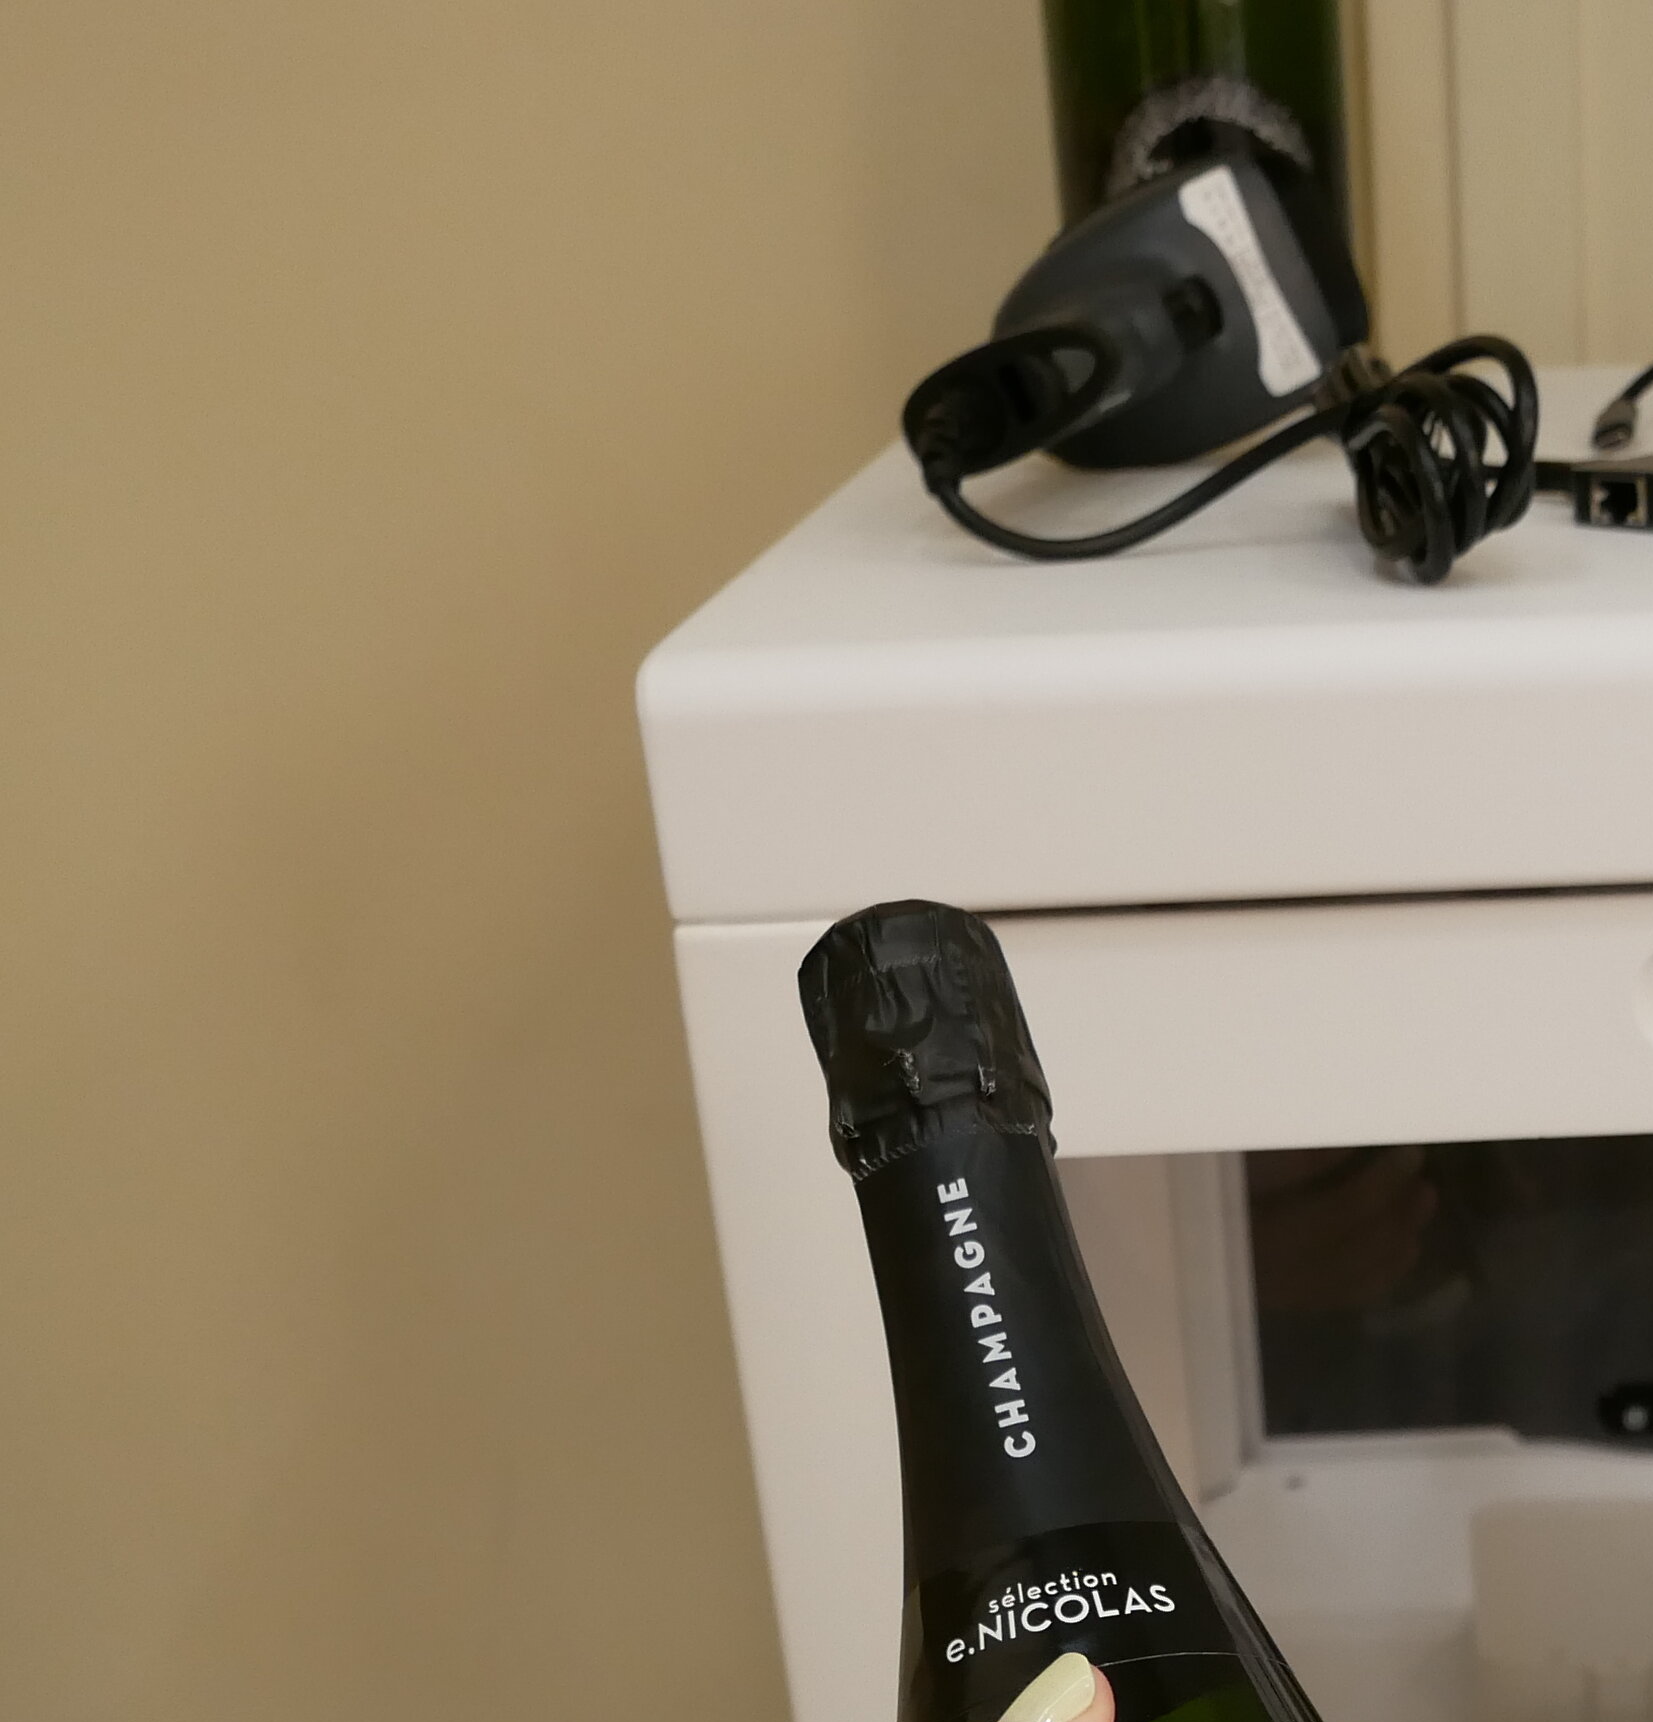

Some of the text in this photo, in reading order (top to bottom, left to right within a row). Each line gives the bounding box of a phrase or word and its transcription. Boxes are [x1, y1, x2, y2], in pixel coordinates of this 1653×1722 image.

[937, 1177, 1037, 1459] CHAMPAGNE
[946, 1584, 1176, 1663] e.NICOLAS
[988, 1571, 1118, 1614] sélection
